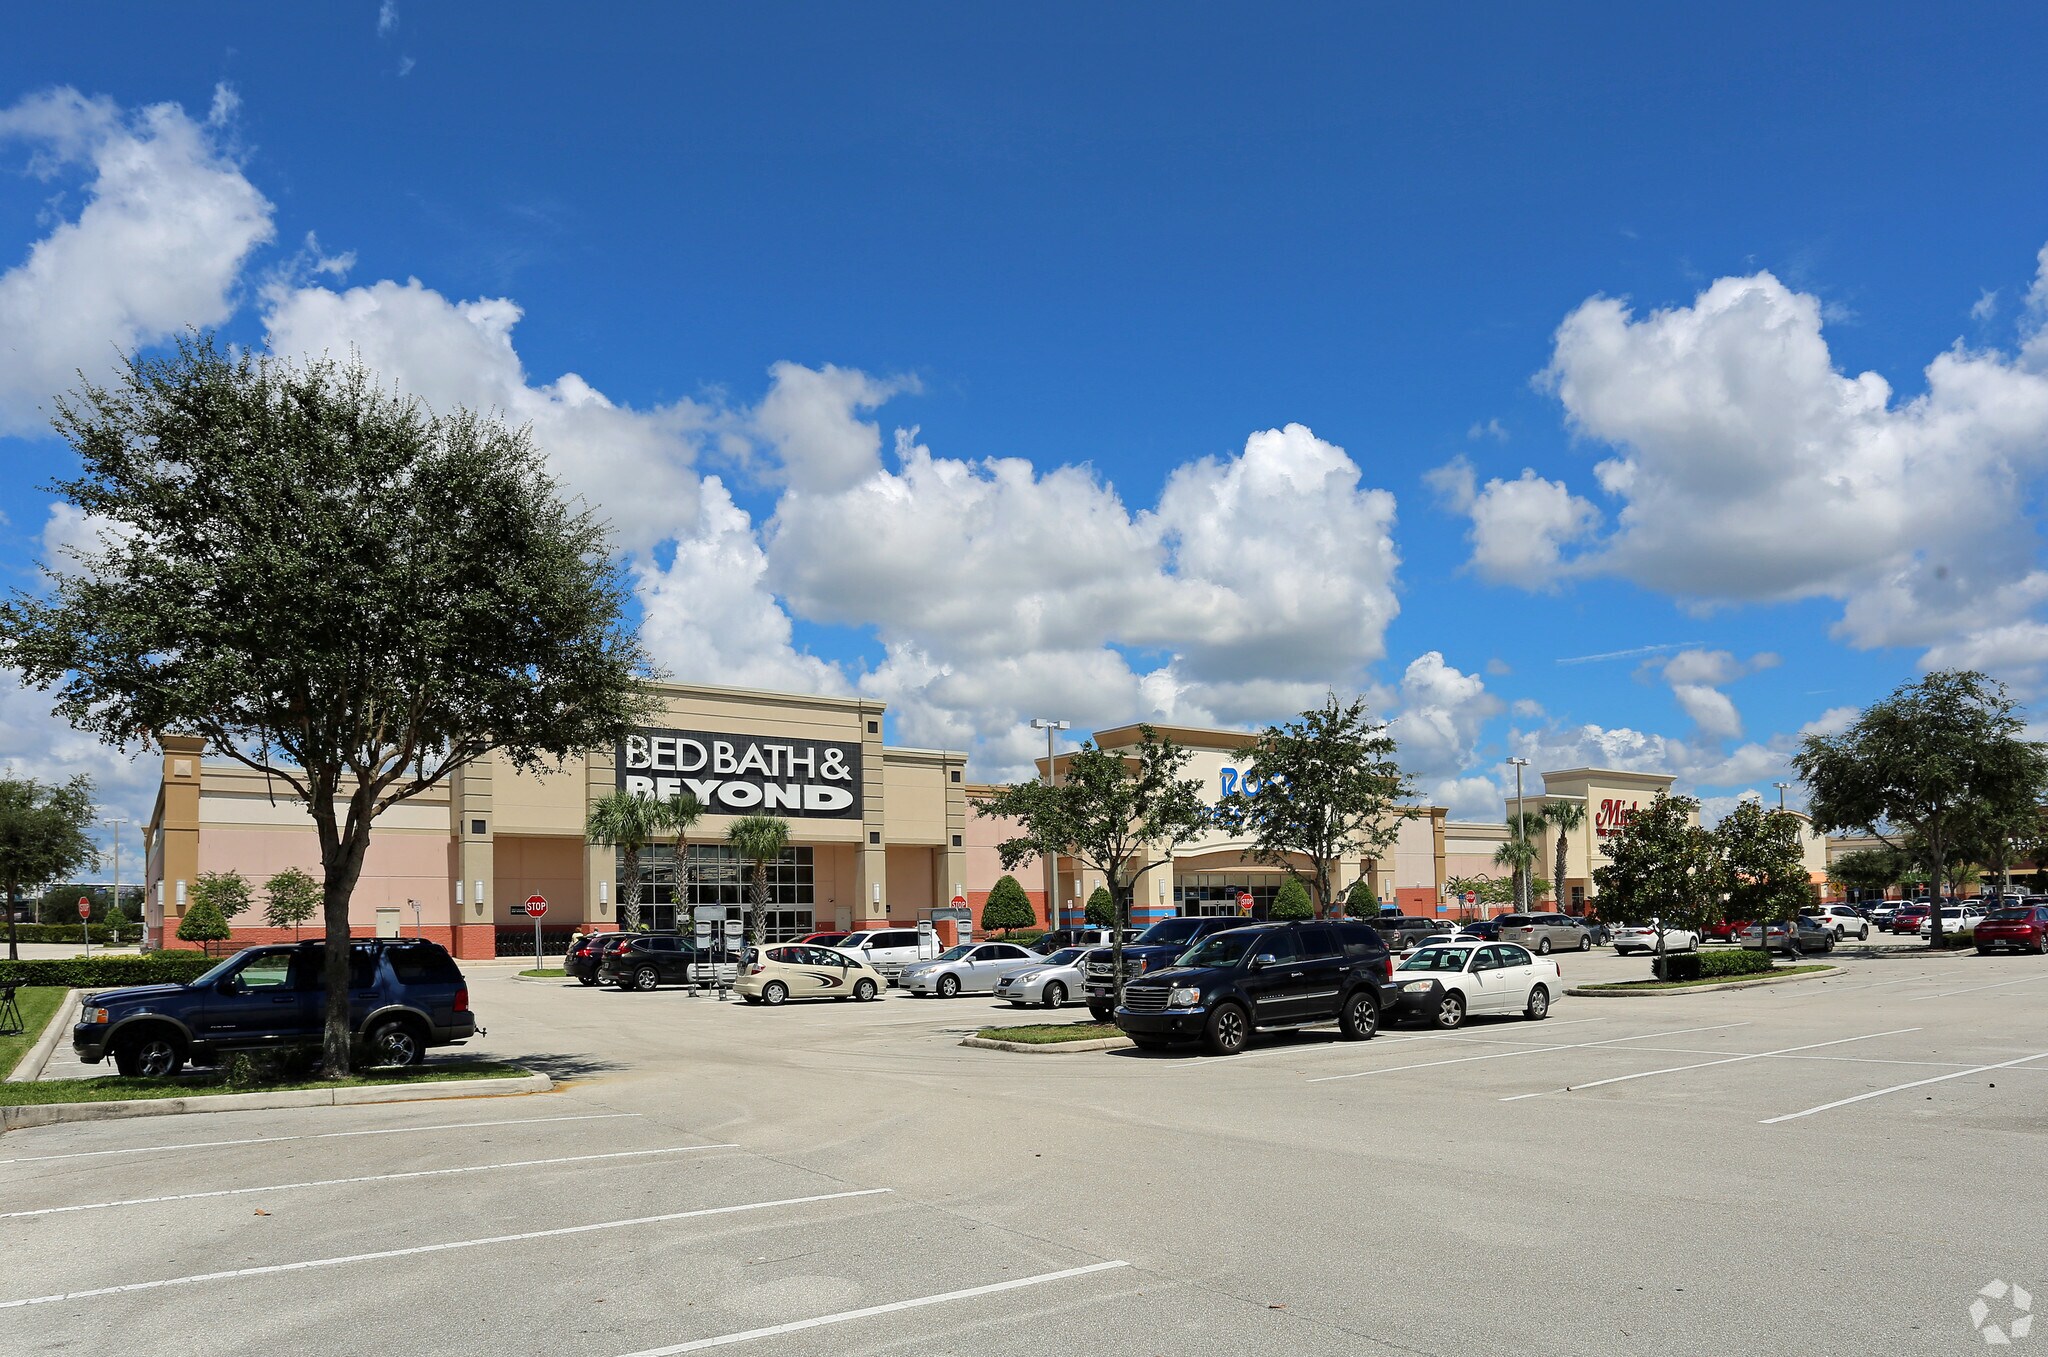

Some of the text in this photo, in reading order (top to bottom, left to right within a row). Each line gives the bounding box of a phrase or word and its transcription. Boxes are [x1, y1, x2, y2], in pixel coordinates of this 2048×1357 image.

[626, 734, 853, 781] BED BATH &
[625, 775, 854, 811] BEYOND
[526, 902, 546, 911] STOP
